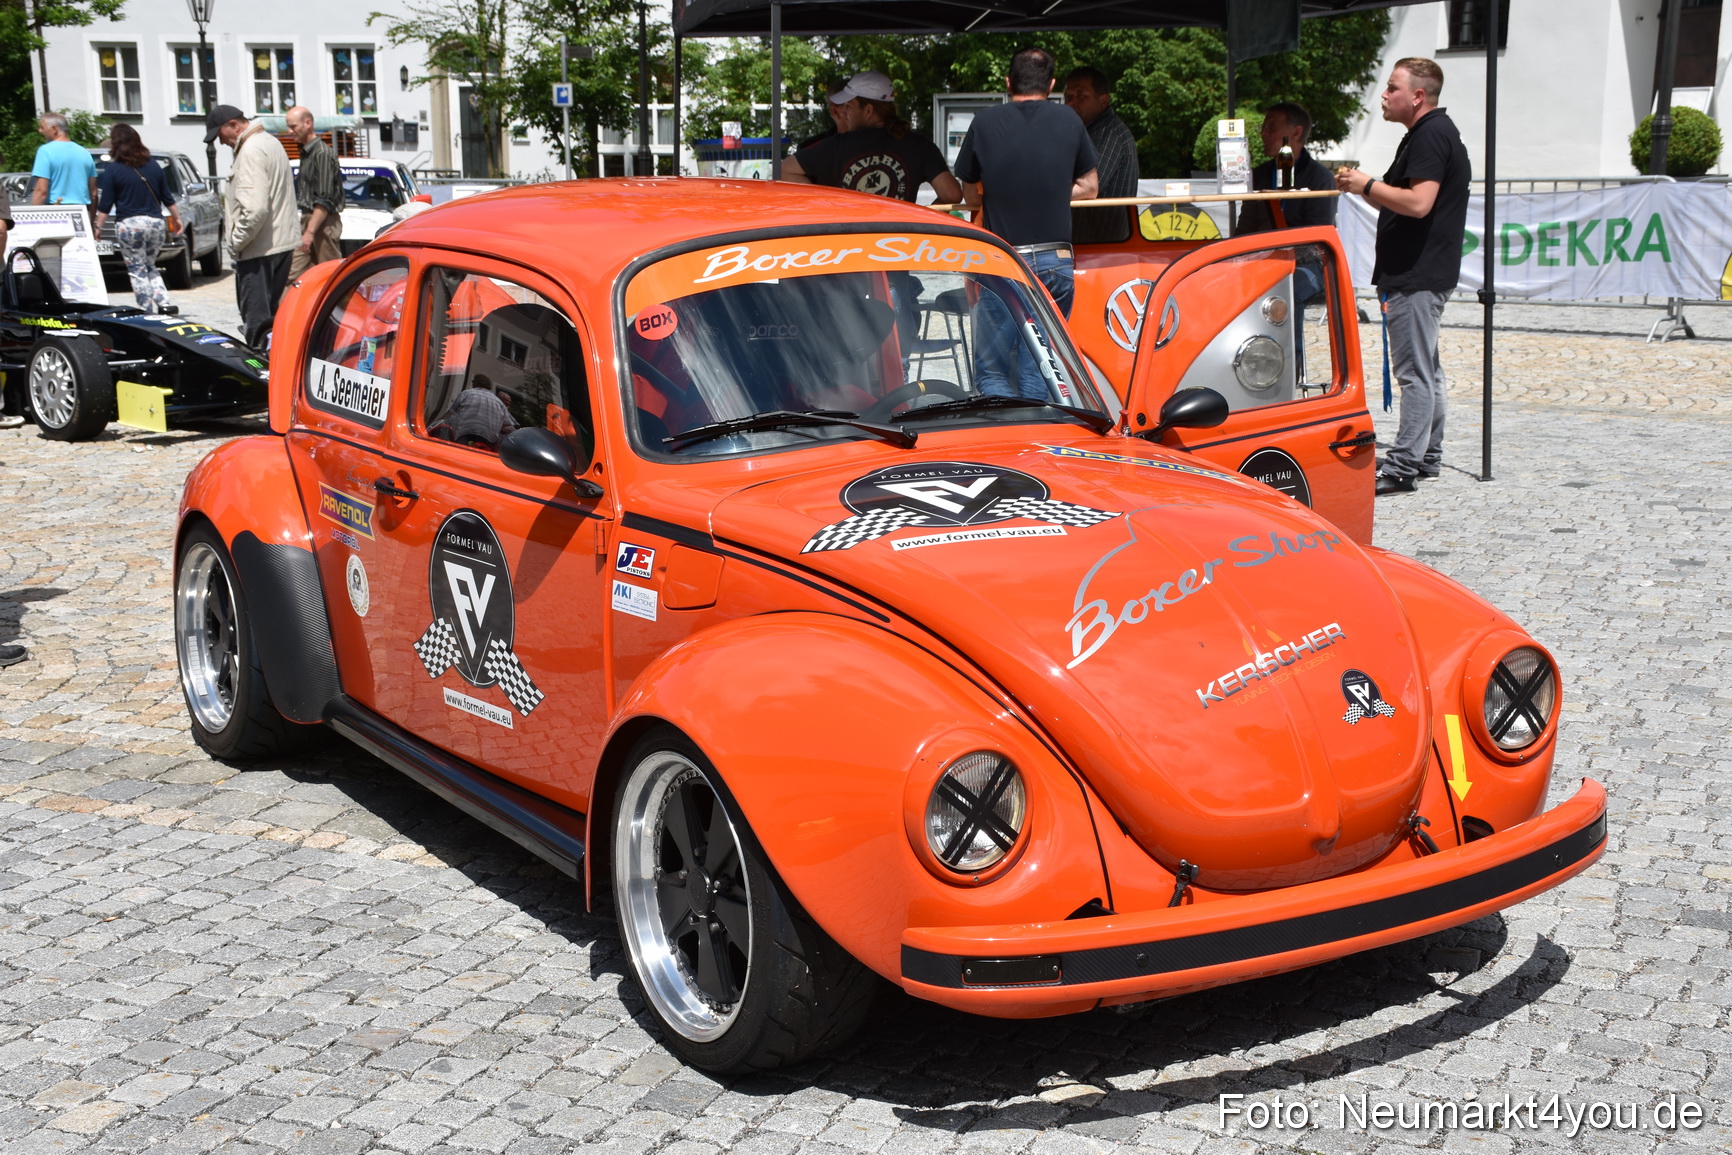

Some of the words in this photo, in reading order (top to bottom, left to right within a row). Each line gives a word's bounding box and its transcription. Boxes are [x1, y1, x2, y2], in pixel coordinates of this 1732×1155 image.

[842, 154, 906, 186] BAVARIA
[1168, 214, 1182, 231] 12
[1185, 220, 1199, 238] 11
[1501, 212, 1672, 267] DEKRA
[693, 246, 863, 284] Boxer
[867, 237, 988, 270] Shop
[165, 323, 213, 336] 777
[639, 311, 674, 333] BOX
[748, 324, 799, 340] parco
[316, 364, 328, 400] A.
[331, 367, 386, 418] Seemeier
[880, 470, 945, 480] FORMEL
[1276, 470, 1292, 480] VAU
[323, 493, 369, 528] RAVENOL
[446, 532, 475, 550] FORMEL
[477, 541, 493, 555] VAU
[896, 527, 1063, 548] www.formel-vau.eu
[617, 546, 653, 570] JE
[626, 566, 650, 577] PISTONS
[1065, 558, 1224, 670] Boxer
[1228, 528, 1343, 568] Shop
[1195, 622, 1347, 710] KERSCHER
[445, 693, 512, 726] www.formel-vau.eu
